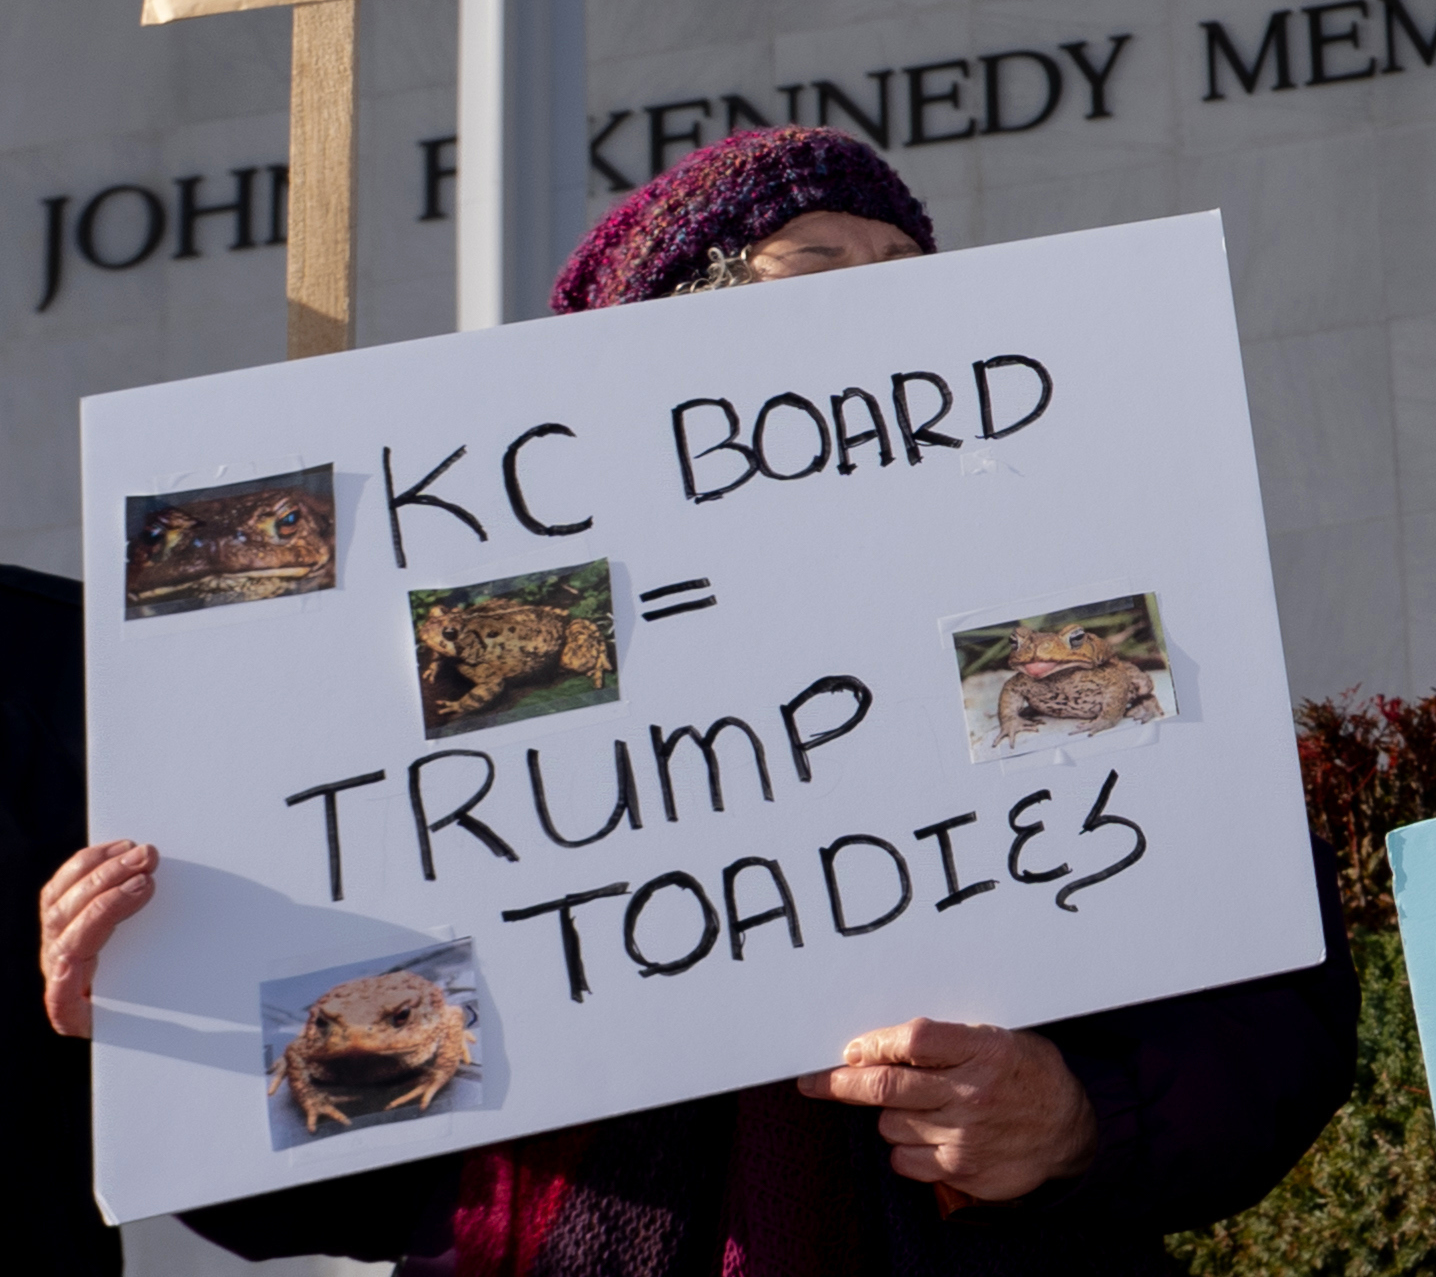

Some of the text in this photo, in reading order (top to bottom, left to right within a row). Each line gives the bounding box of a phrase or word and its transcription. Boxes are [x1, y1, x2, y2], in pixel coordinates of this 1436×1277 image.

[35, 162, 290, 313] JOH
[382, 350, 1056, 569] KC BOARD
[501, 768, 1148, 1004] TOADIES
